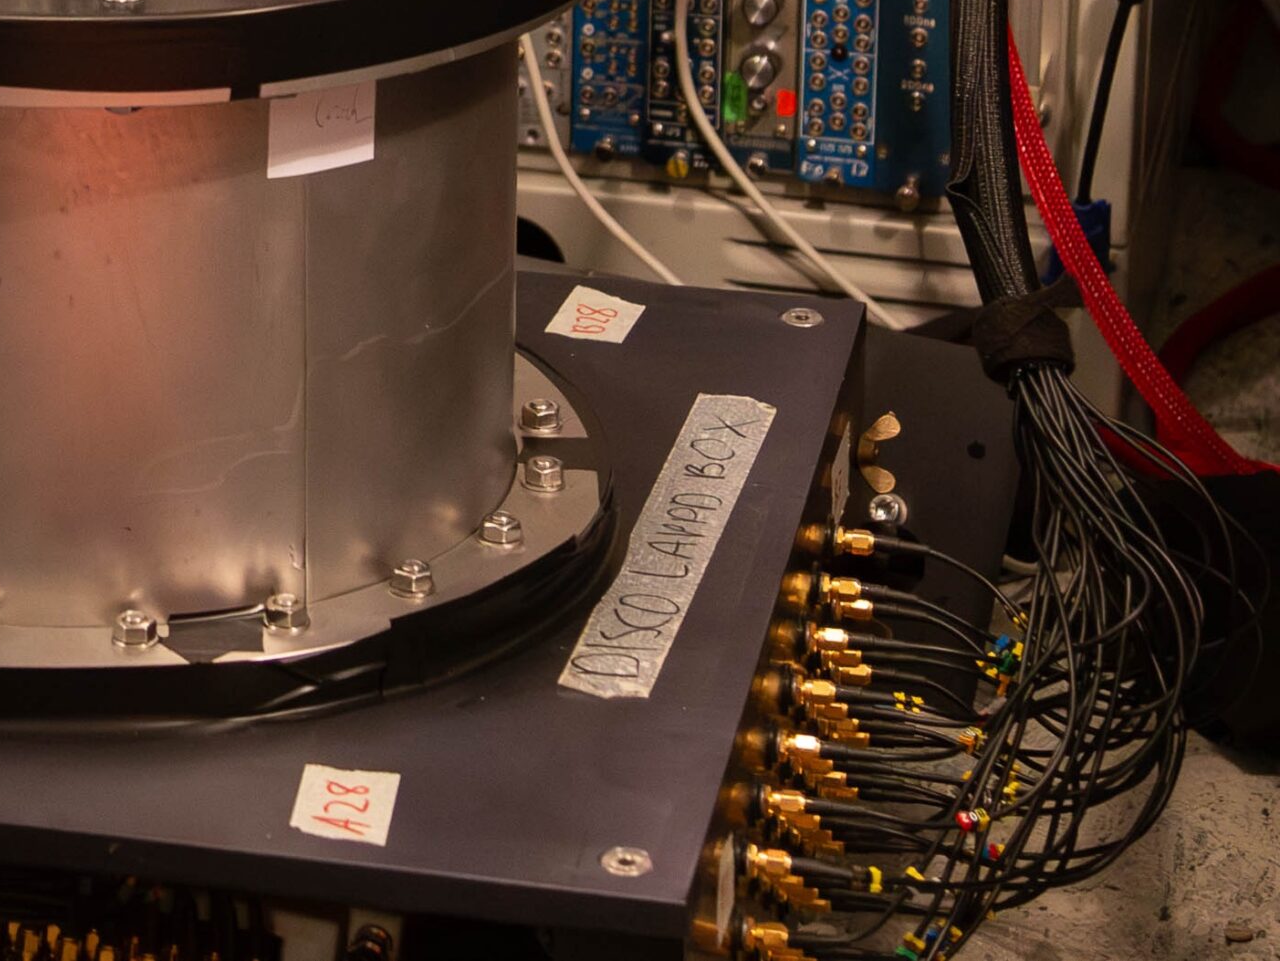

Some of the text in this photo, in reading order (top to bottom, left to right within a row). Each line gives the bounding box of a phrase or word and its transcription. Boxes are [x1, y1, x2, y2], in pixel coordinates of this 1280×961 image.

[570, 302, 619, 335] B28
[570, 592, 681, 680] DISCO
[683, 414, 761, 480] BOX
[310, 778, 372, 837] A28
